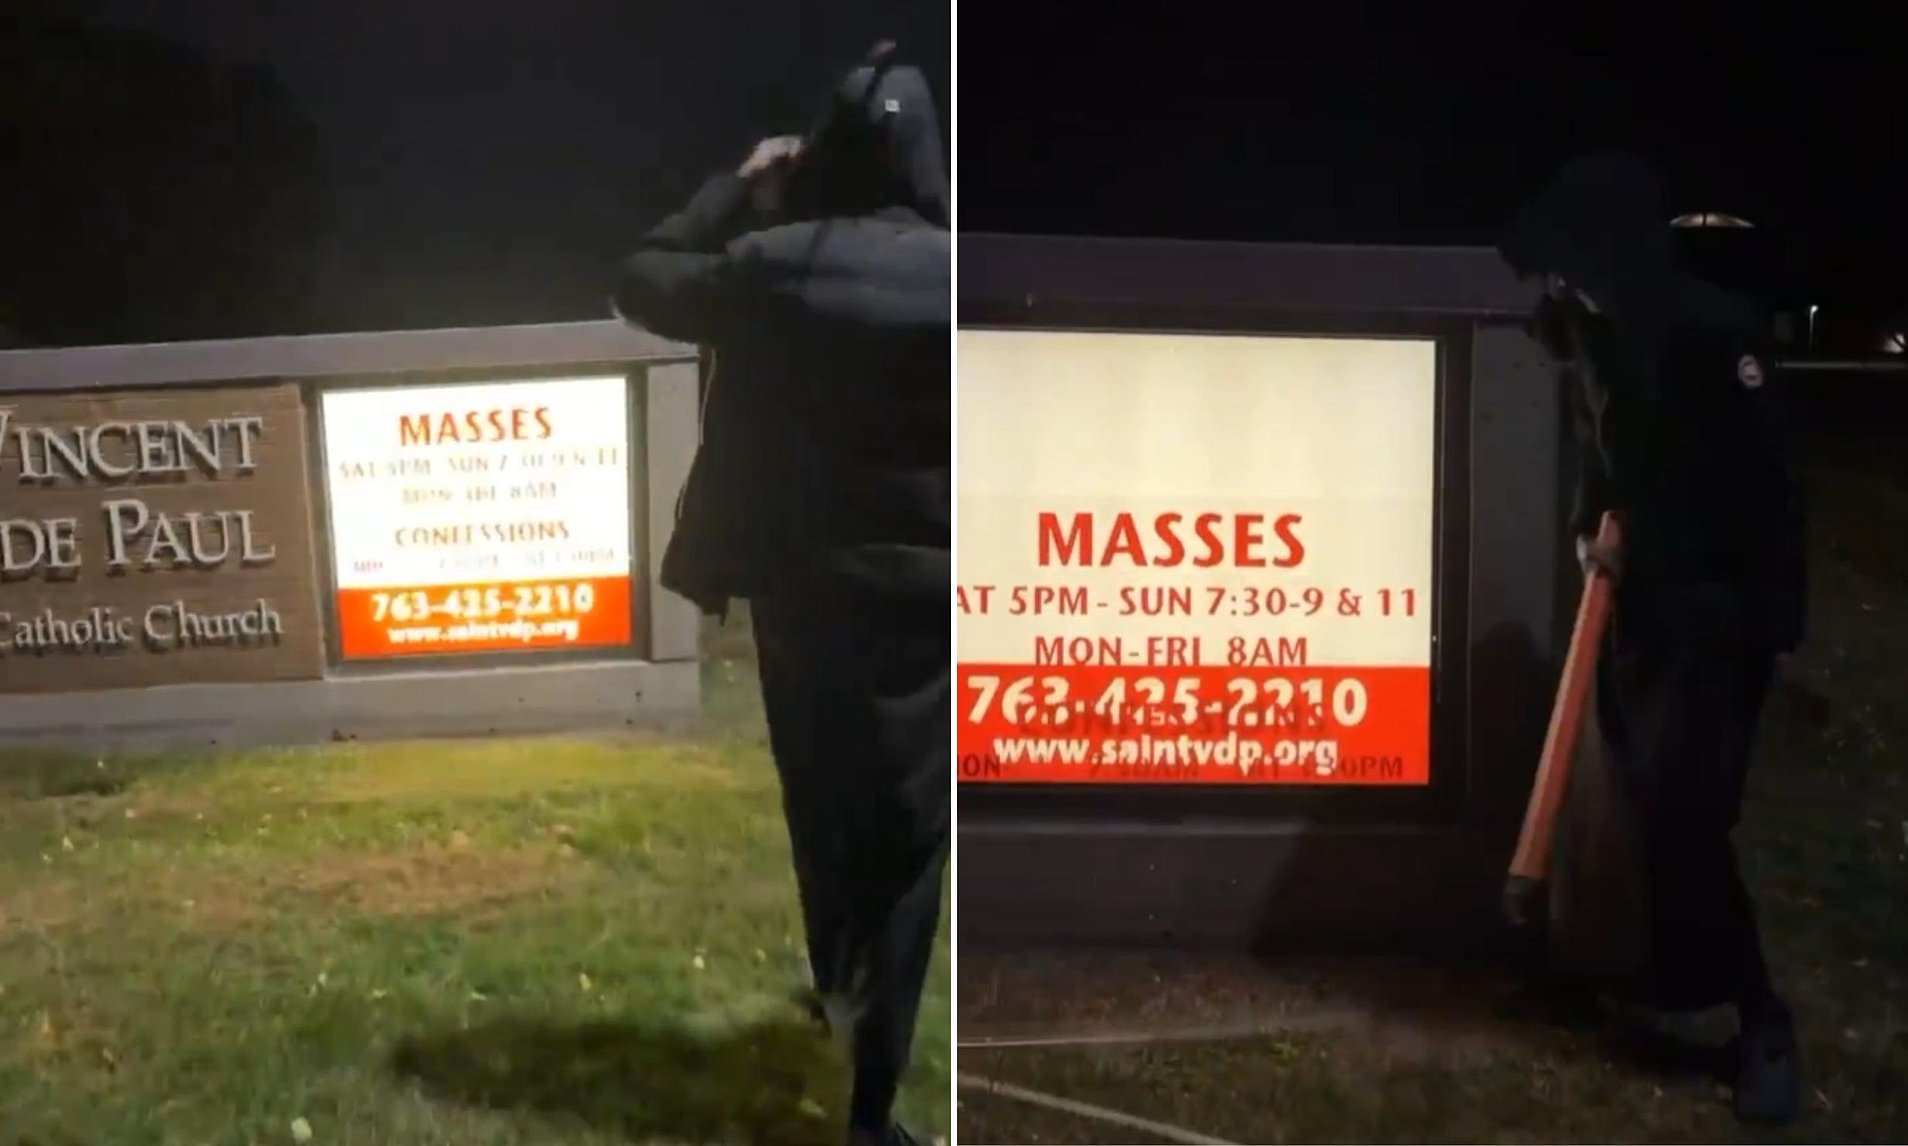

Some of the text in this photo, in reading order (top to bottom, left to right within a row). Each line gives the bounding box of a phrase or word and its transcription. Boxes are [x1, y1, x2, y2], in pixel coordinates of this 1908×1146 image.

[399, 406, 553, 448] MASSES
[102, 498, 276, 567] PAUL
[1037, 511, 1306, 568] MASSES
[144, 598, 284, 641] Church
[371, 583, 594, 622] 763-425-2210
[1009, 585, 1089, 616] 5PM
[1118, 586, 1193, 616] SUN
[1337, 587, 1363, 617] &
[1377, 587, 1416, 618] 11
[1227, 635, 1308, 667] 8AM
[967, 674, 1368, 728] 763-425-2210
[993, 730, 1338, 776] www.saintvdp.org
